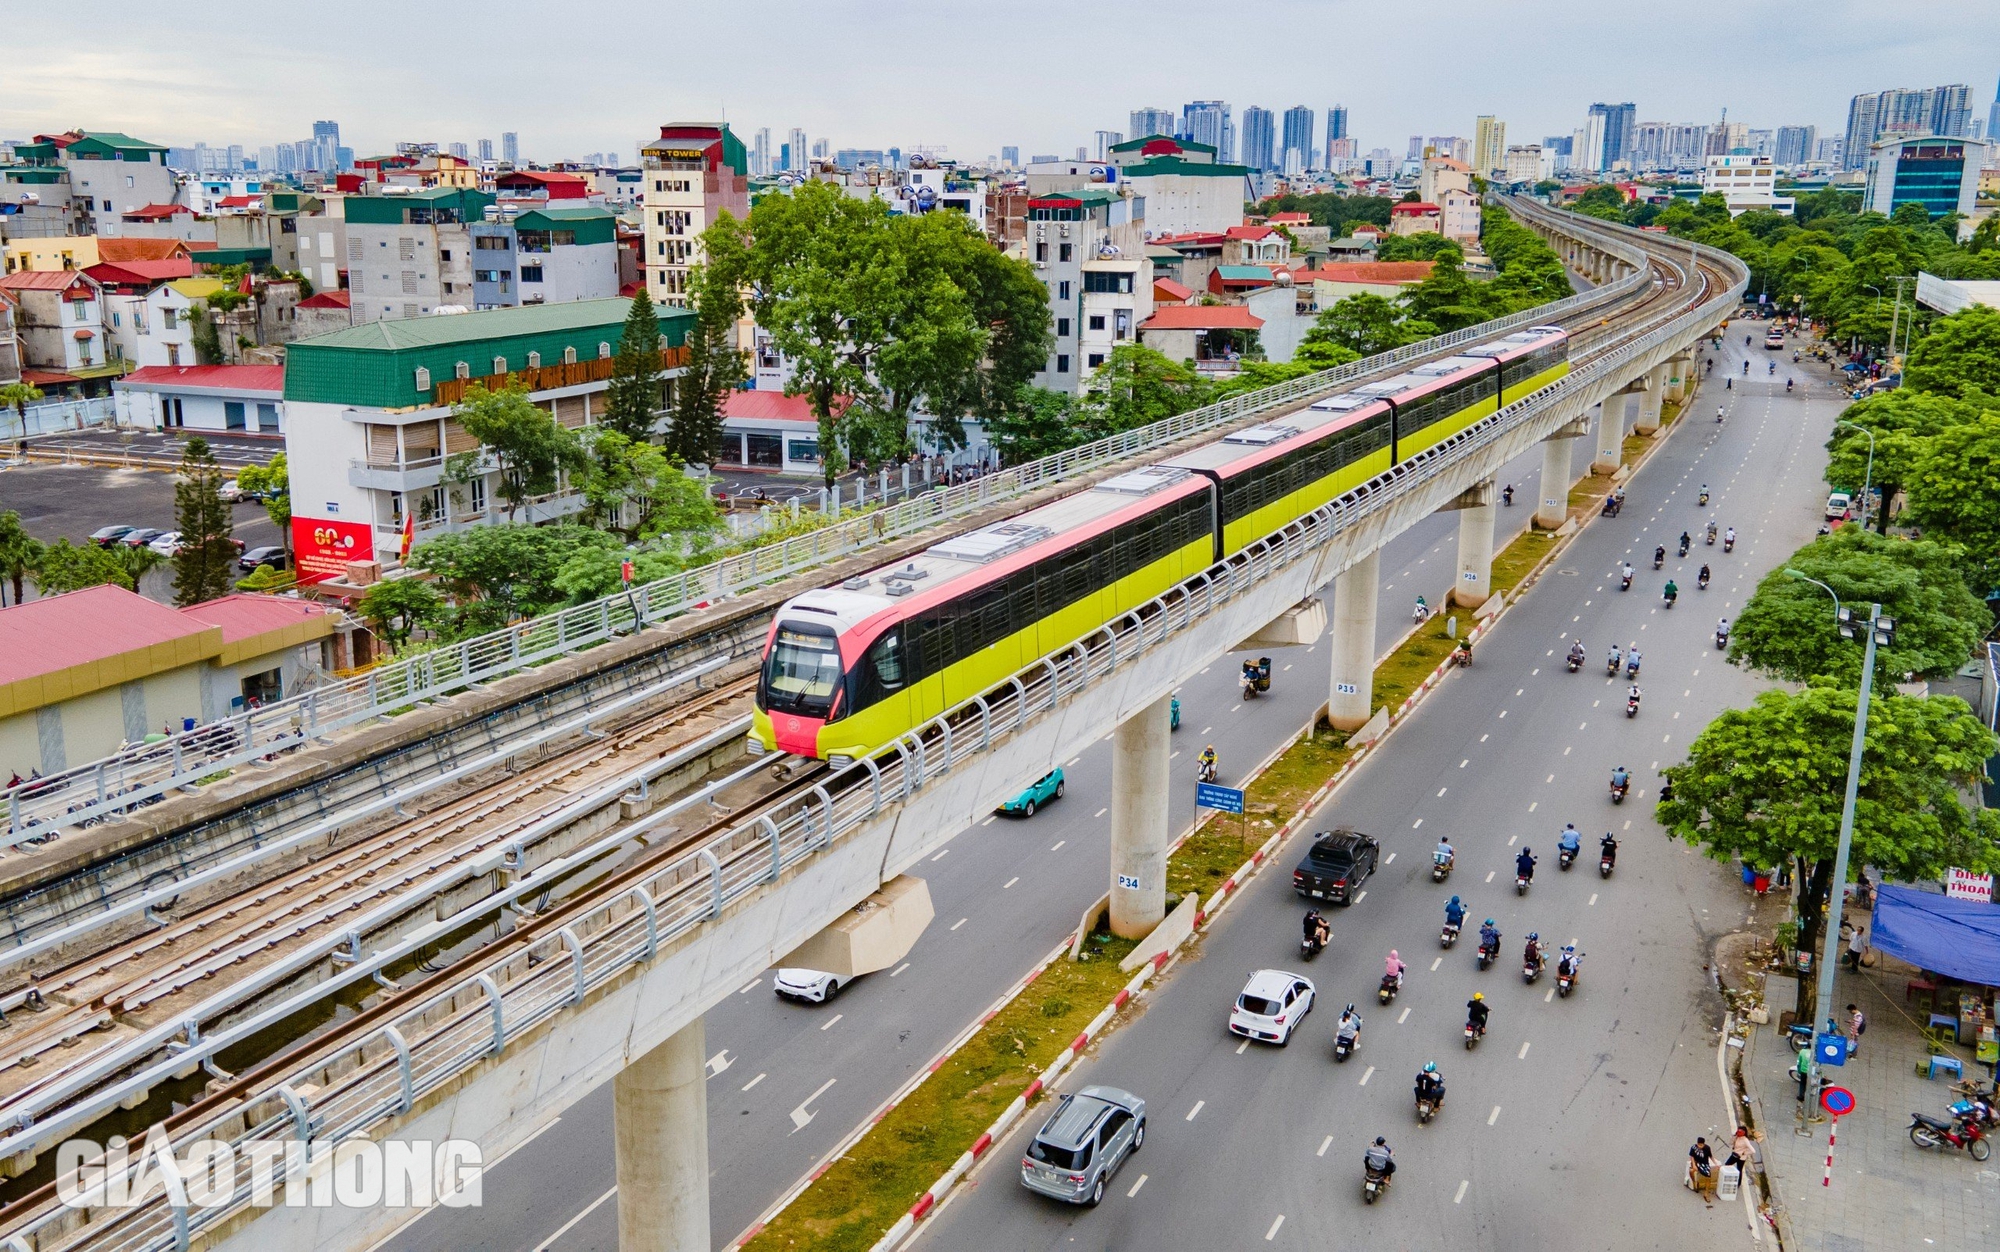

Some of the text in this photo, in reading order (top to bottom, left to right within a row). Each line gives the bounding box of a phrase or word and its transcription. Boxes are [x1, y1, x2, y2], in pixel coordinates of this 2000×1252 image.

[314, 527, 338, 545] 60
[1464, 573, 1477, 581] P36
[1338, 684, 1355, 694] P35
[1119, 876, 1138, 889] P34
